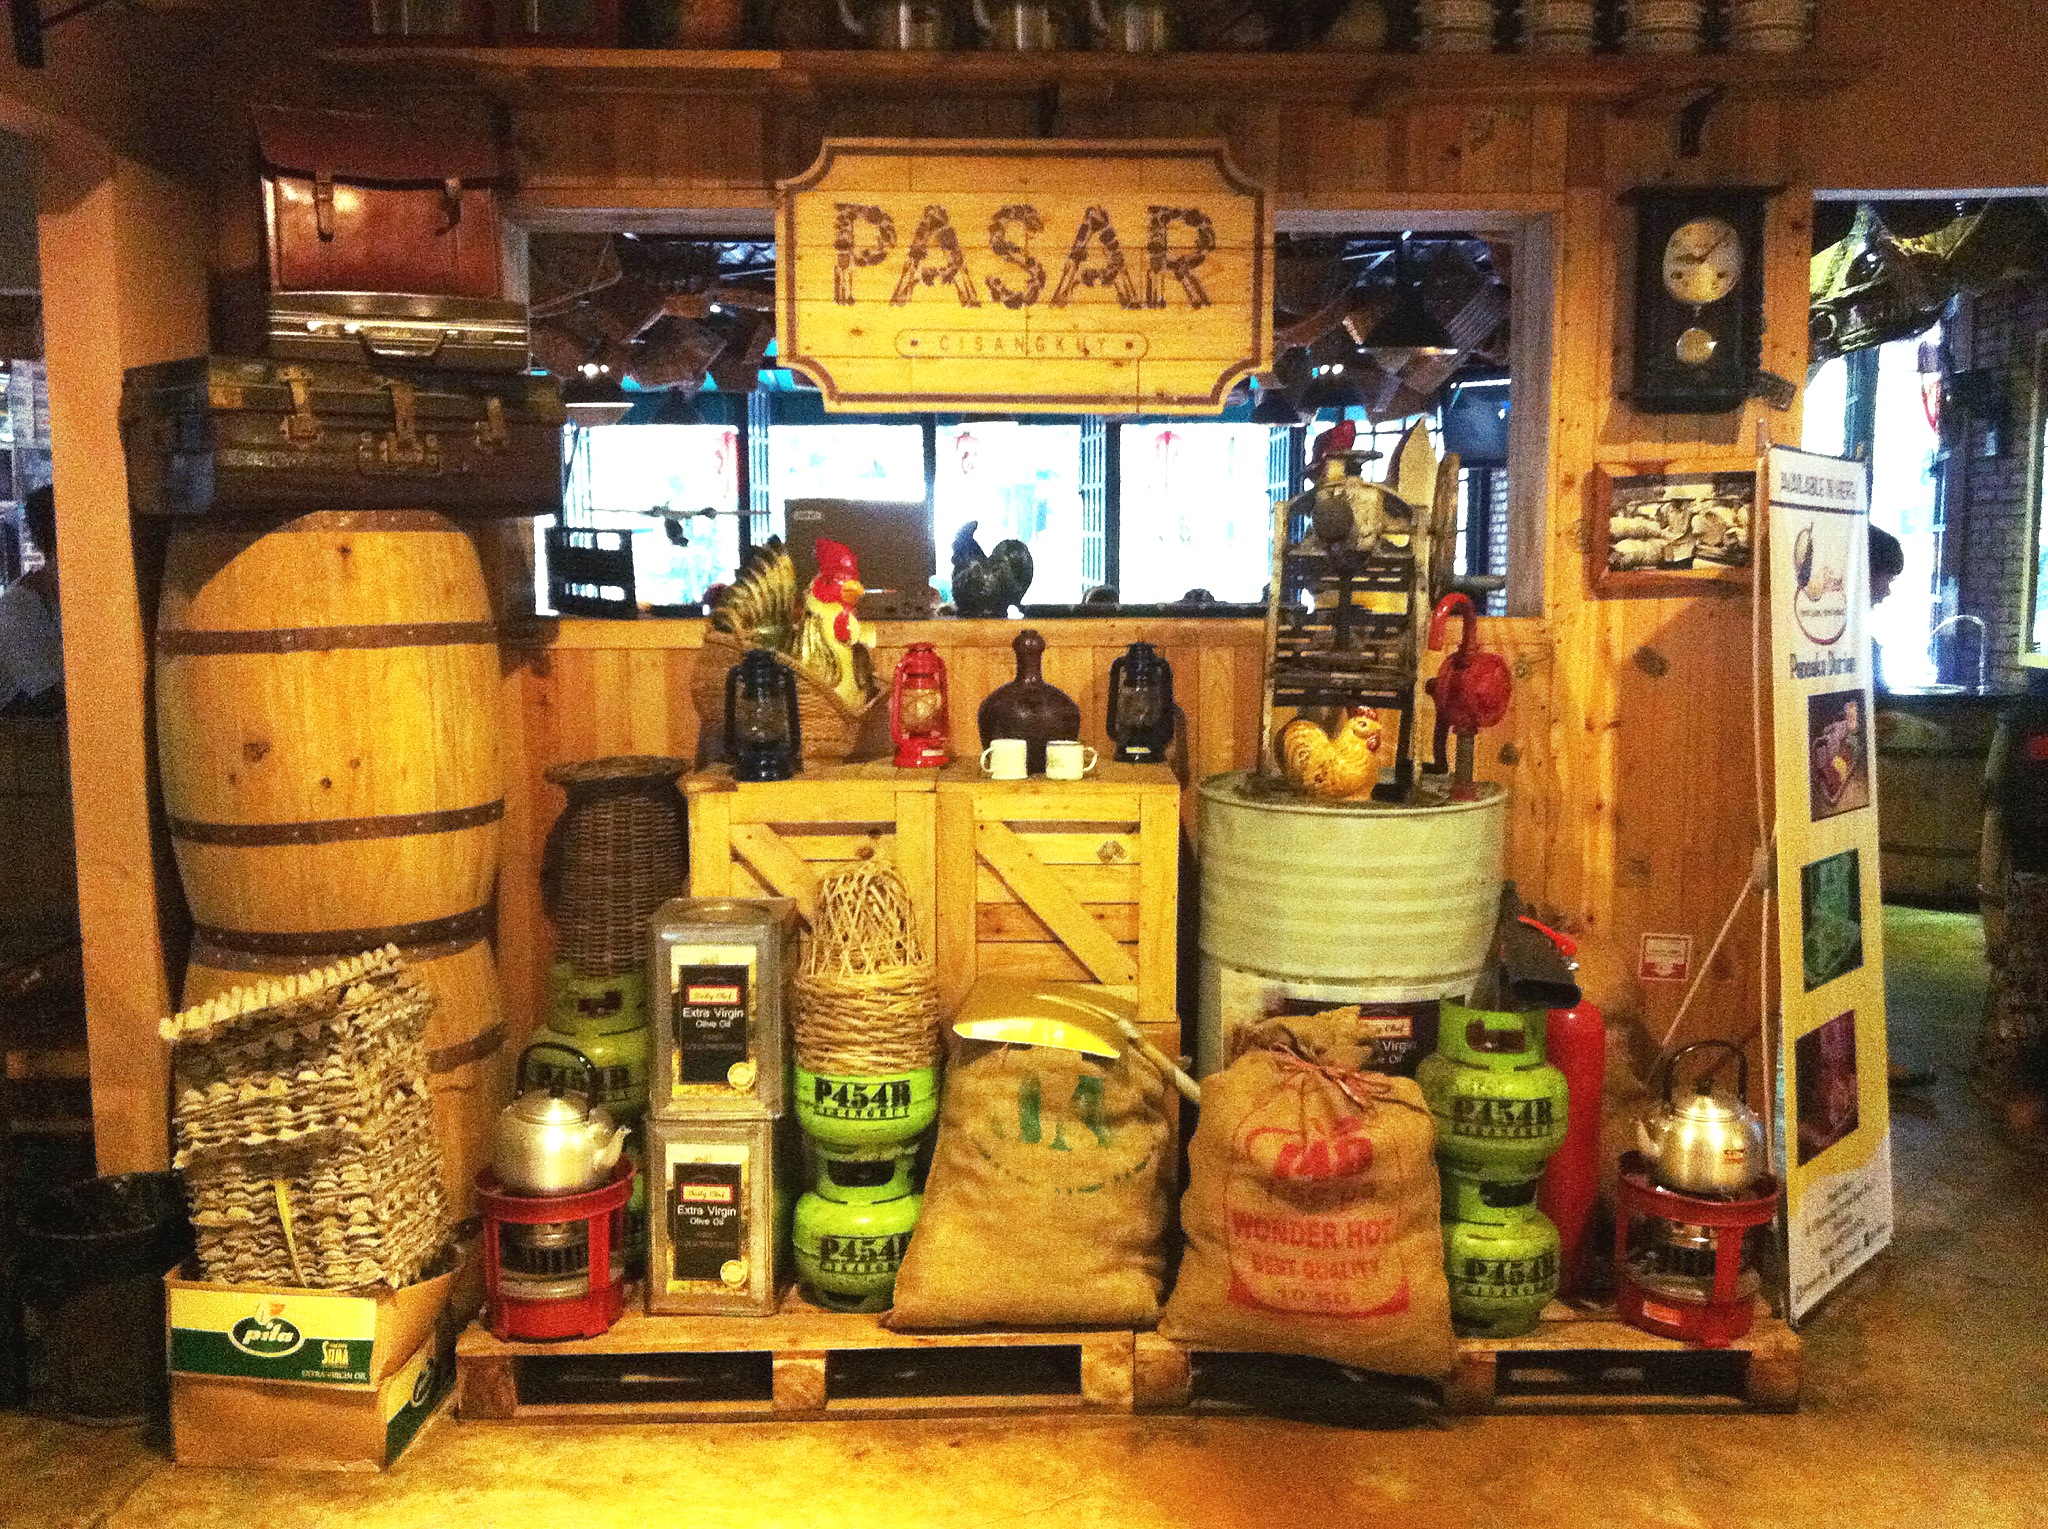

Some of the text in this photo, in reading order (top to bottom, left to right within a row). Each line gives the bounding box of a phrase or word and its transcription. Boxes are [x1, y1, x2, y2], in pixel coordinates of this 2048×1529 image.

[834, 202, 1216, 309] PASAR
[939, 334, 1107, 355] CISANGKUY
[682, 1006, 744, 1019] Extra Virgin
[695, 1018, 731, 1027] Olive Oil
[677, 1204, 737, 1218] Extra Virgin
[689, 1217, 724, 1226] Olive Oil
